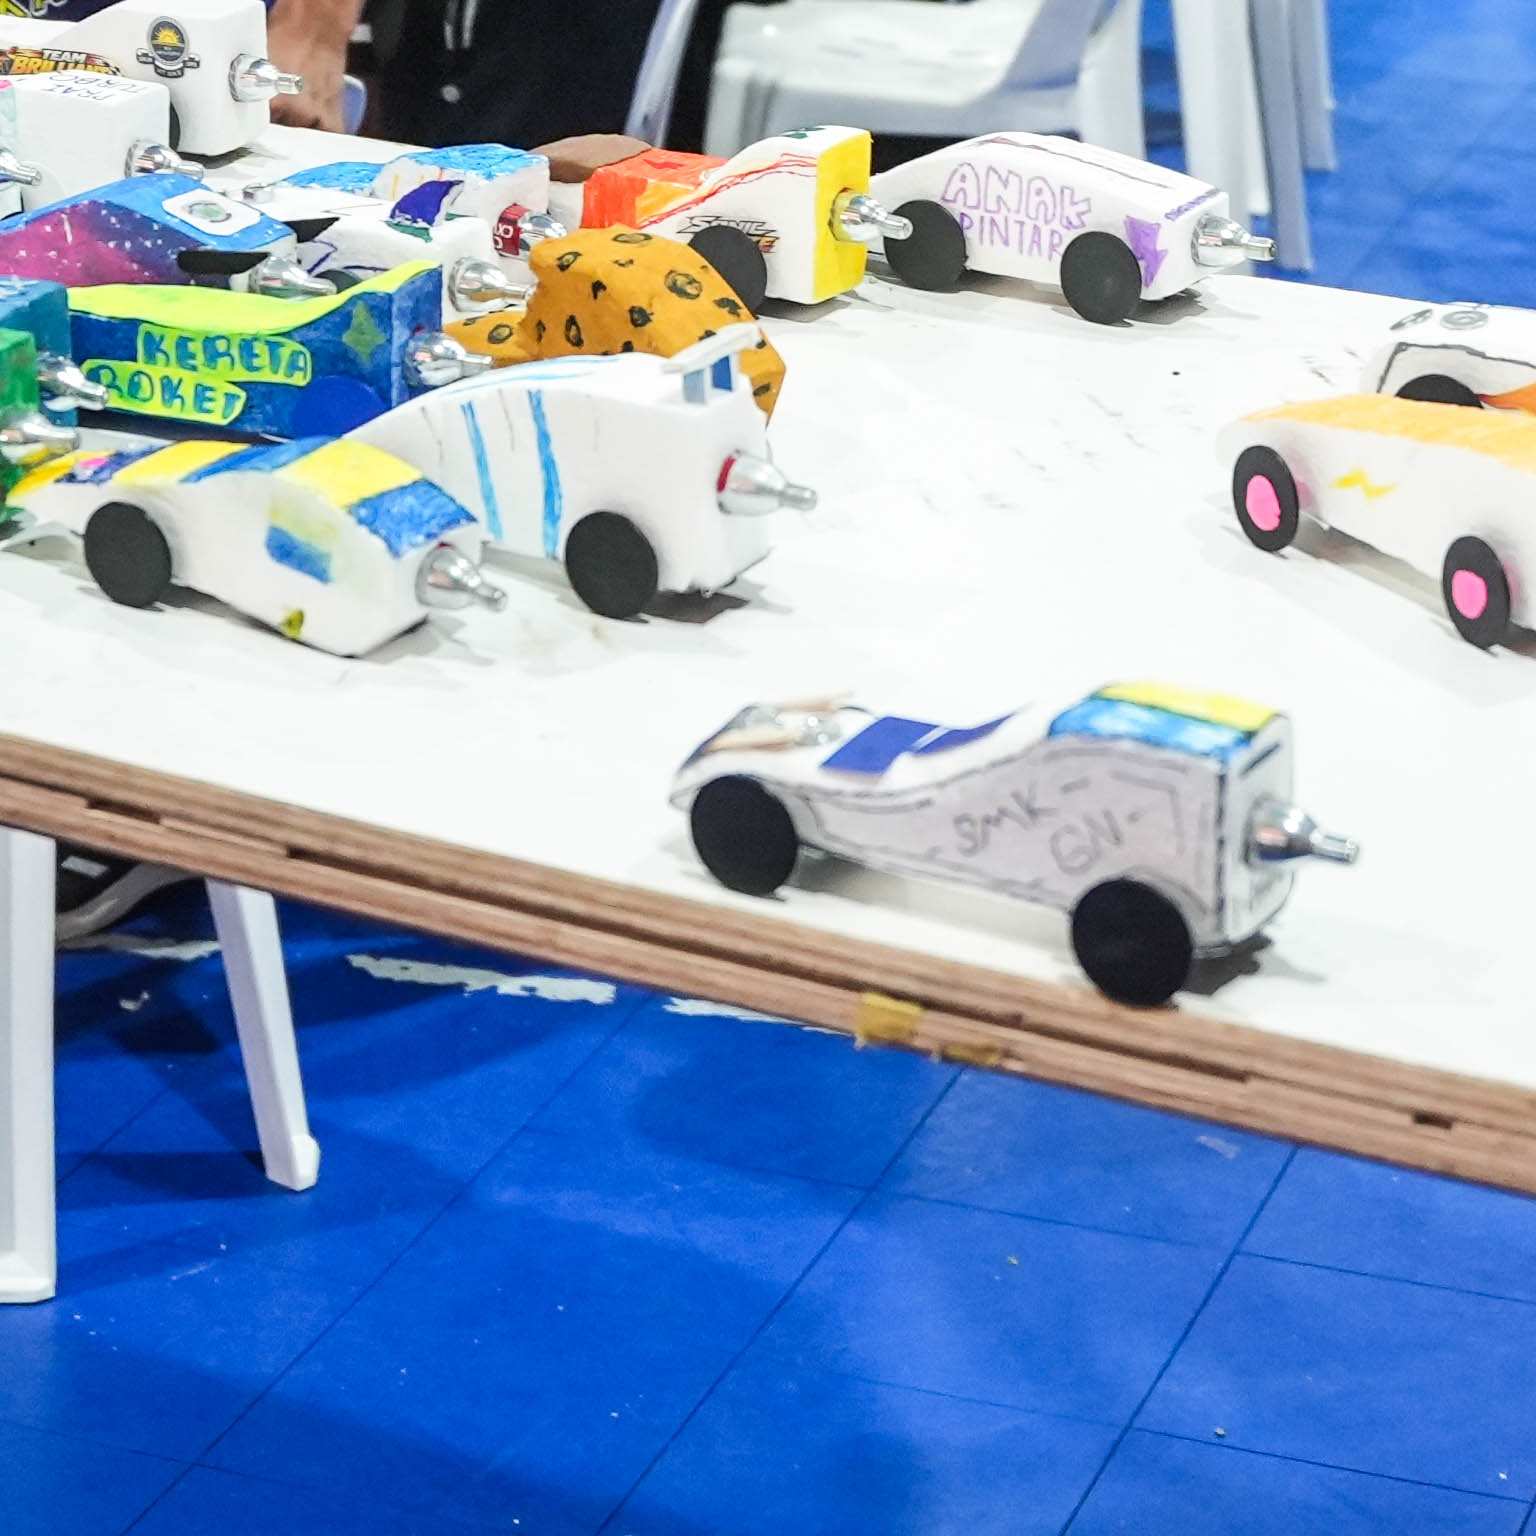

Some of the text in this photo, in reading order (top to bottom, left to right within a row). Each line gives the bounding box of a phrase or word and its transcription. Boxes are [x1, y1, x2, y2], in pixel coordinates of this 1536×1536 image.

[42, 48, 89, 64] TEAM
[940, 161, 1092, 231] ANAK
[958, 212, 1064, 263] PINTAR
[142, 330, 310, 379] KERETA
[85, 363, 243, 420] ROKET
